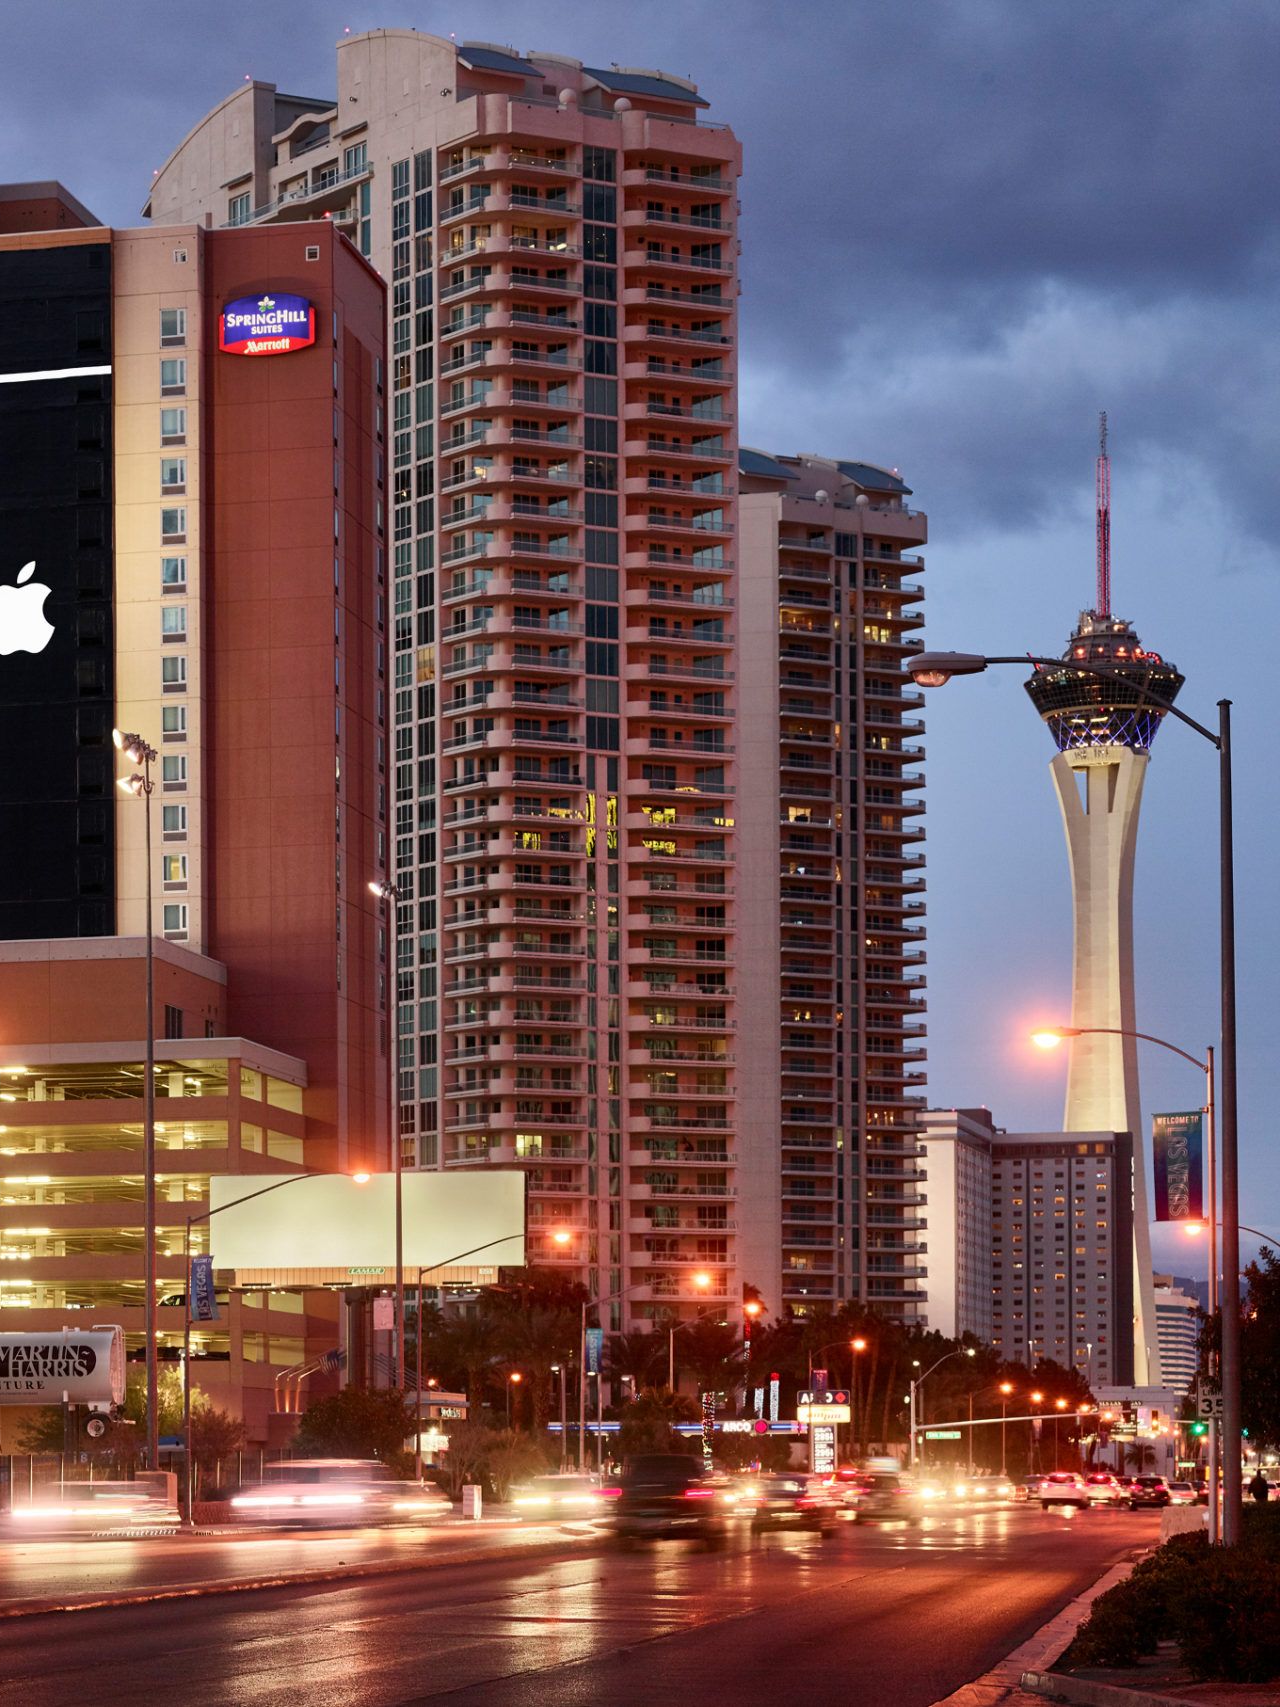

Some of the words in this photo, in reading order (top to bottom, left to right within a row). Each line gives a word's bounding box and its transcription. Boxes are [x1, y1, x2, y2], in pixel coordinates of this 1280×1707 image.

[251, 325, 283, 335] SUITES
[243, 337, 290, 354] Marriott
[1157, 1116, 1188, 1125] WELCOME
[1190, 1115, 1199, 1124] TO
[1167, 1127, 1188, 1160] LAS
[1168, 1163, 1189, 1217] VEGAS
[8, 1359, 88, 1378] HARRIS
[722, 1422, 752, 1432] ARCO
